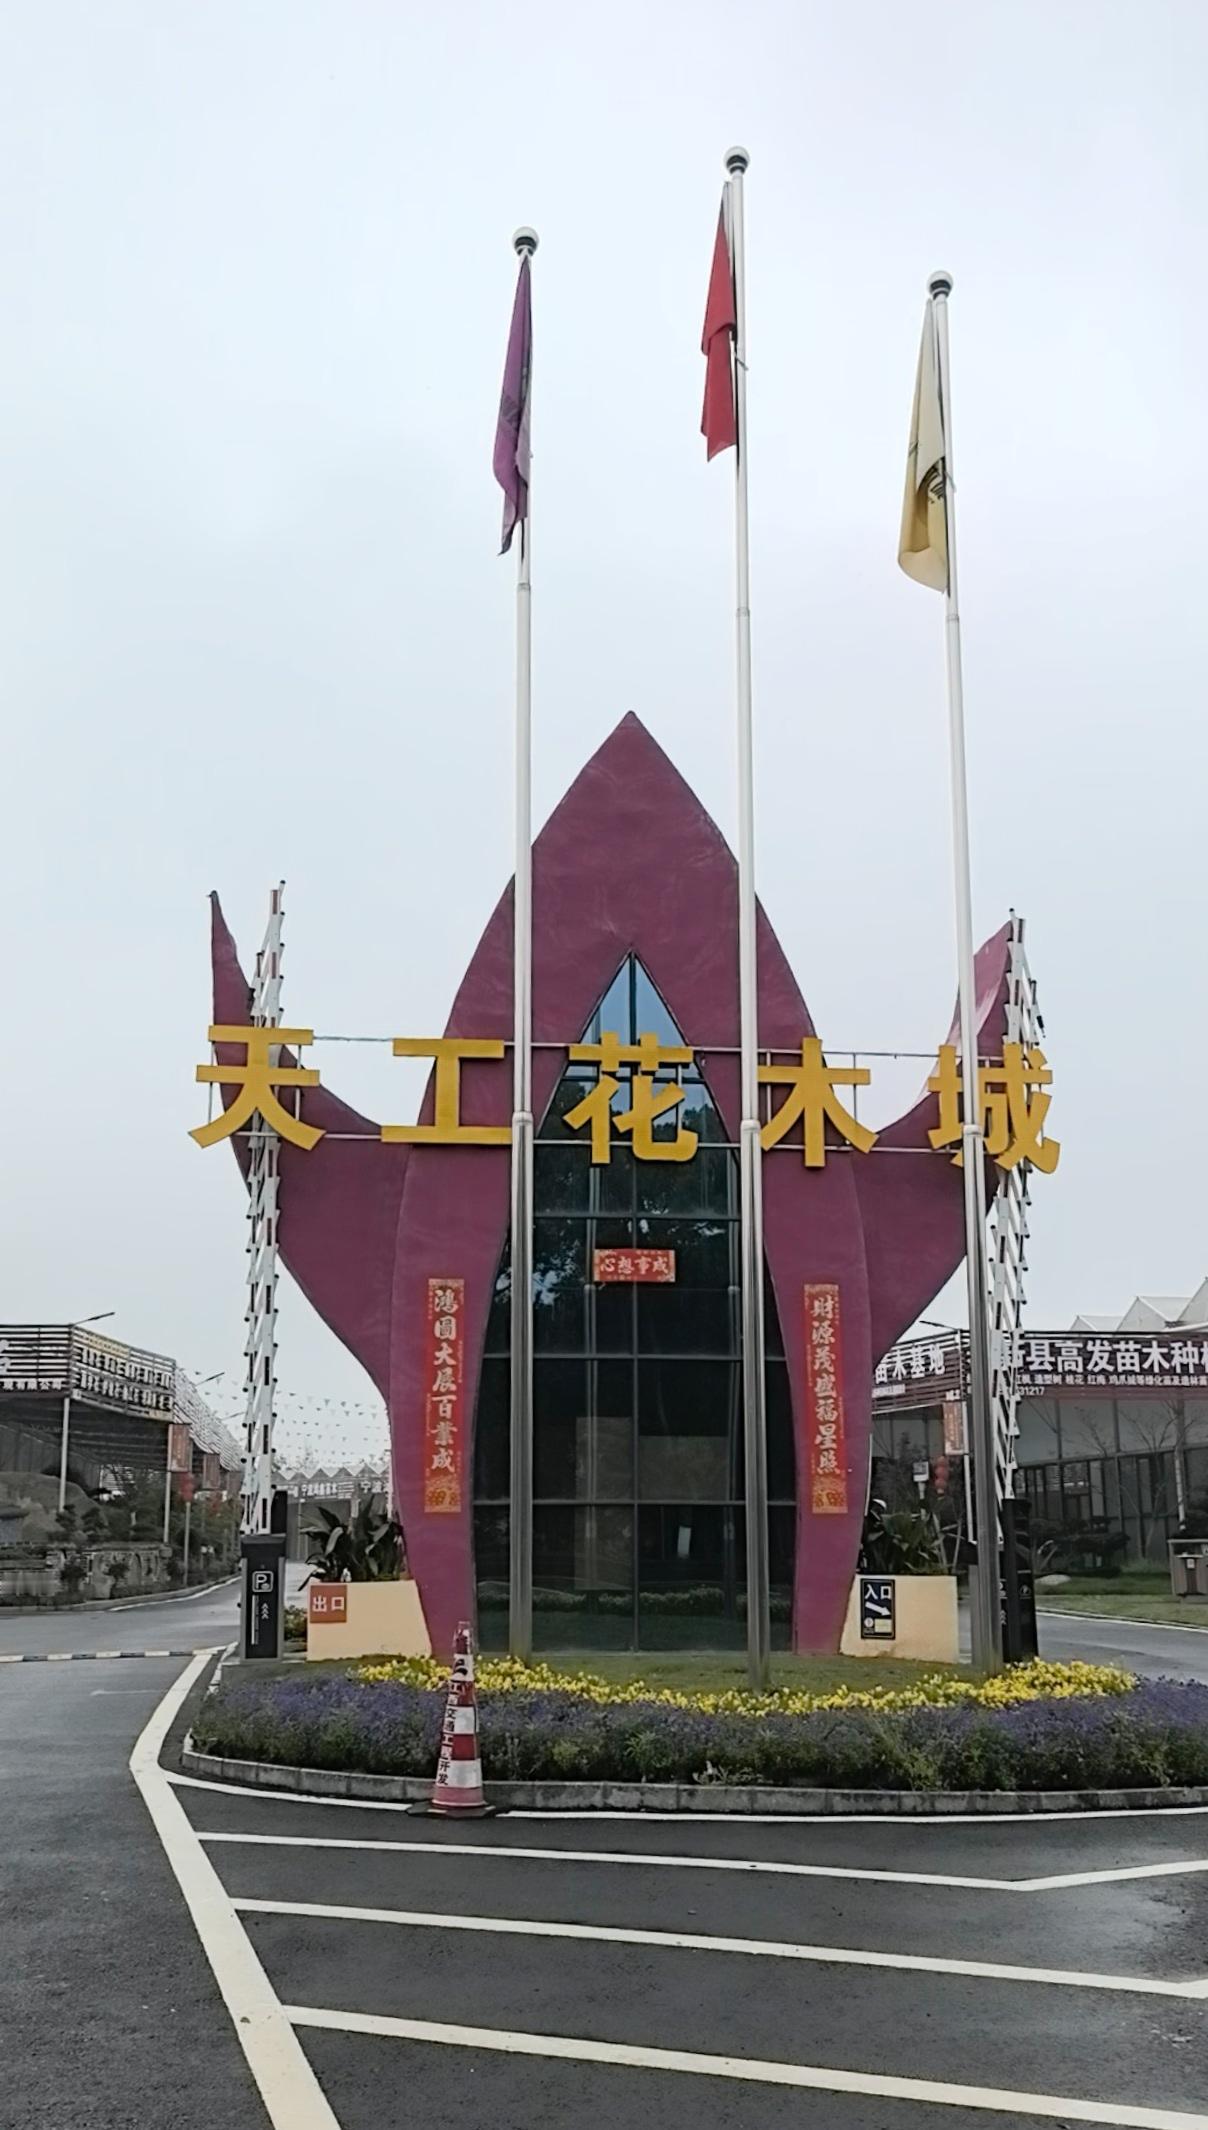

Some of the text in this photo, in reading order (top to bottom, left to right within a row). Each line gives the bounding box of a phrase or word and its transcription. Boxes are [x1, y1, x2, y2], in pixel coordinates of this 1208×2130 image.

[188, 1025, 1060, 1173] 天工花木城
[600, 1256, 669, 1276] 心想事成
[1008, 1340, 1208, 1374] 县高发苗木种
[864, 1584, 892, 1600] 入口
[312, 1595, 345, 1613] 出口
